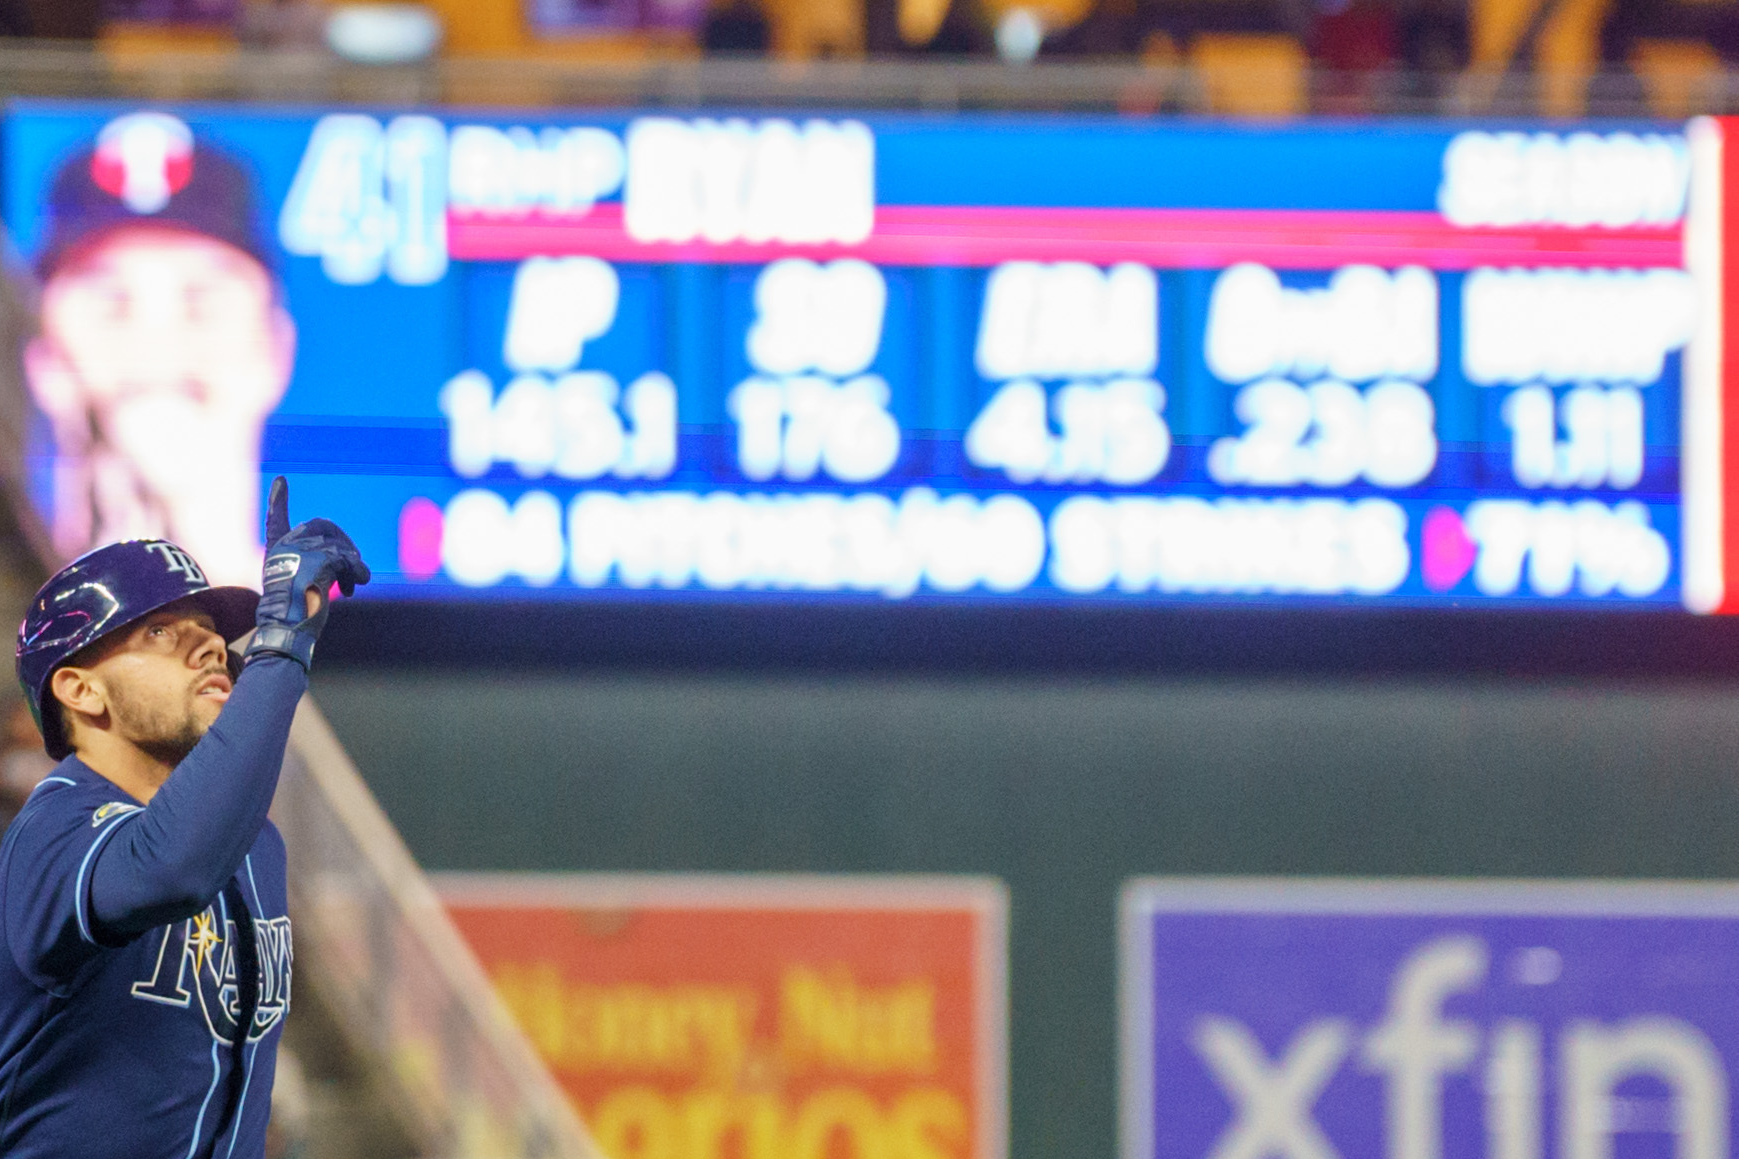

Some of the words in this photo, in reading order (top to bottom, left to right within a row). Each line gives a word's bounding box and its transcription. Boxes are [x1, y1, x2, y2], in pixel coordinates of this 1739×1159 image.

[281, 116, 446, 284] 41
[624, 119, 874, 244] RYAN
[444, 374, 675, 477] 145.1
[734, 376, 898, 480] 176
[144, 542, 206, 584] TB
[780, 960, 934, 1074] Nut
